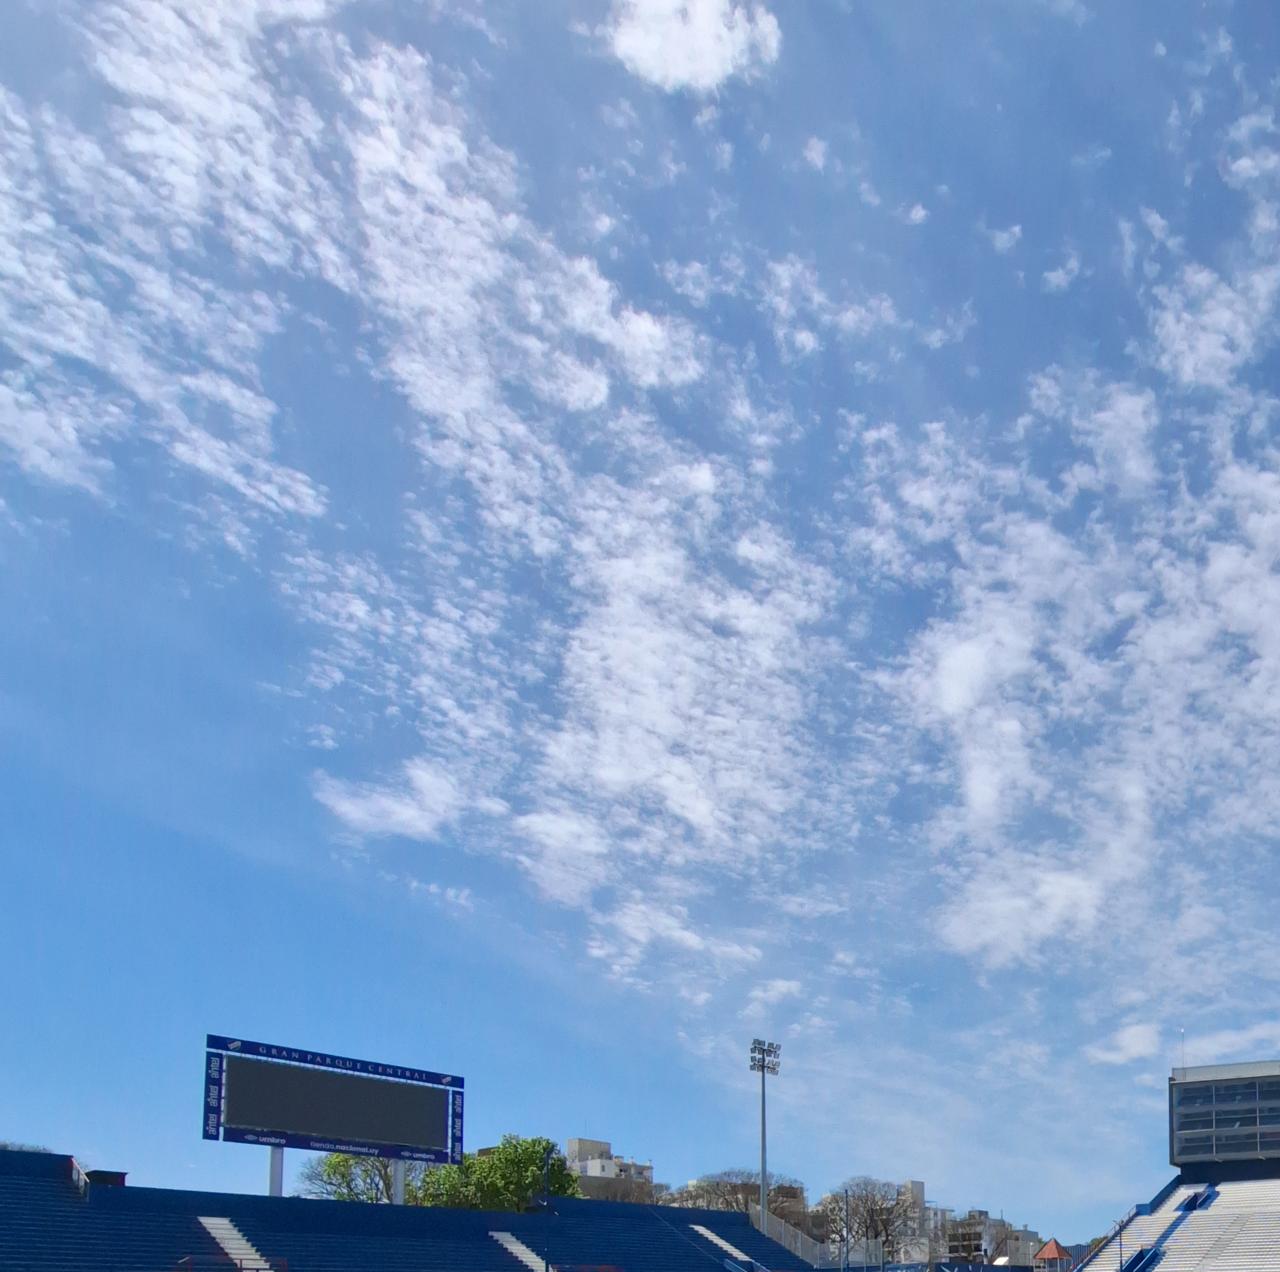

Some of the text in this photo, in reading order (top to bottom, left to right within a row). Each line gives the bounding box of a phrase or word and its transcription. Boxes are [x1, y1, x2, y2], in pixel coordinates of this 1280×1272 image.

[208, 1057, 220, 1079] antel
[259, 1046, 428, 1079] GRAN PARQUE CENTRAL
[207, 1085, 218, 1107] antel
[206, 1113, 217, 1135] antel
[258, 1135, 287, 1145] umbro
